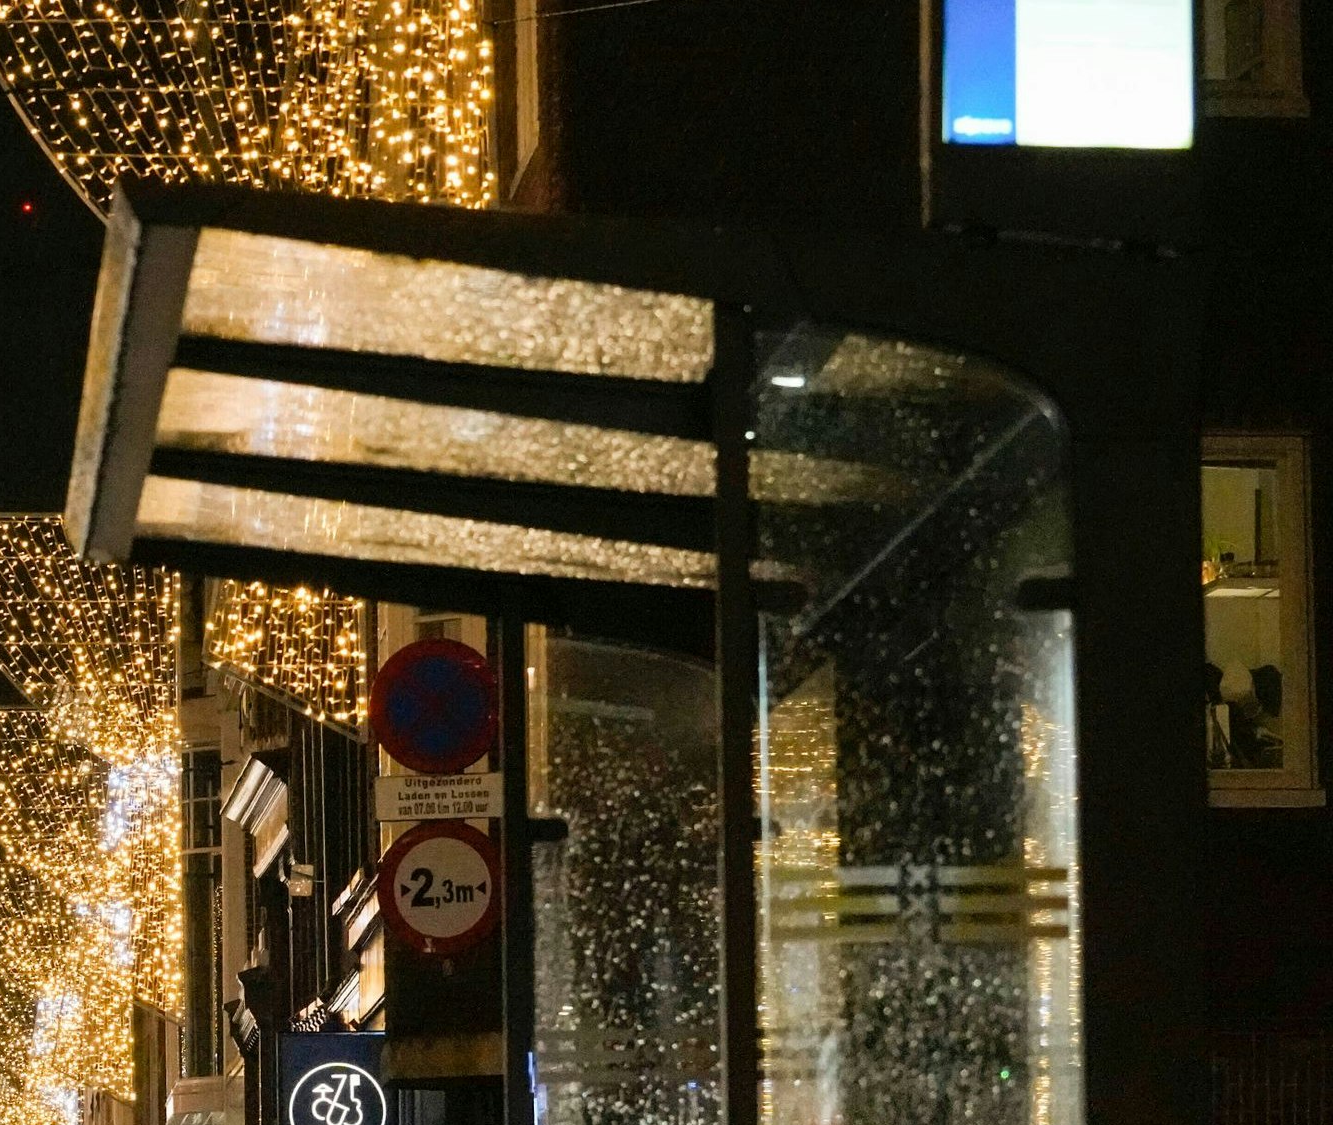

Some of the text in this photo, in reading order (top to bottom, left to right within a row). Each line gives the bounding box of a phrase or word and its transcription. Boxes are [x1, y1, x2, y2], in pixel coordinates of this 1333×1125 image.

[405, 776, 482, 789] Uitgezonderd
[398, 789, 490, 801] Laden en Lossen
[410, 868, 475, 909] 2,3m
